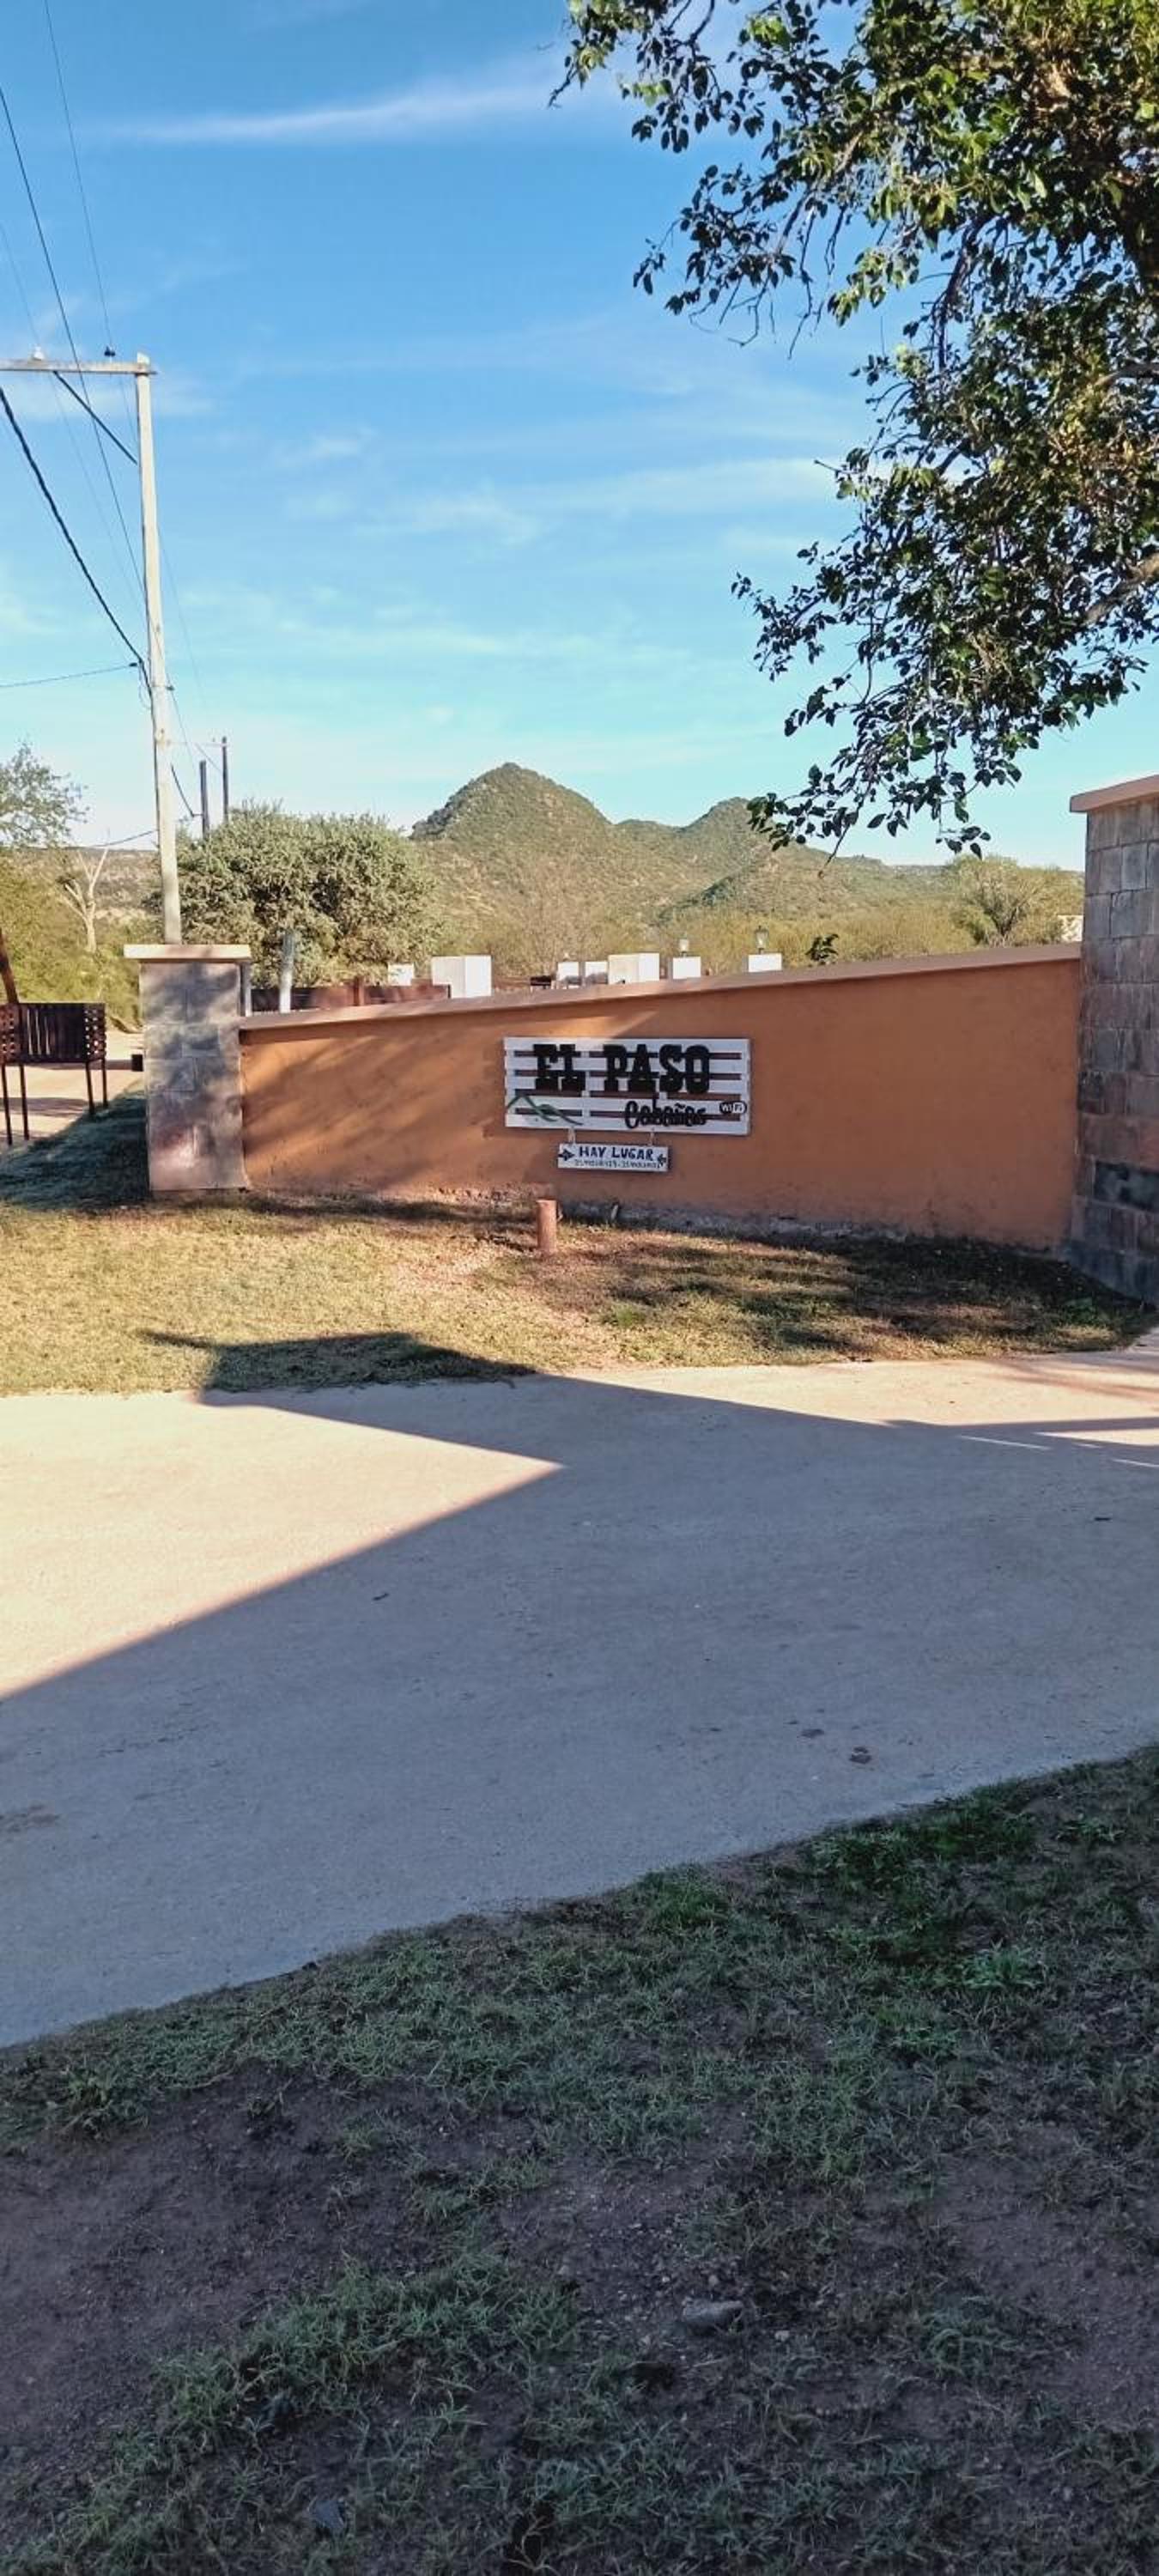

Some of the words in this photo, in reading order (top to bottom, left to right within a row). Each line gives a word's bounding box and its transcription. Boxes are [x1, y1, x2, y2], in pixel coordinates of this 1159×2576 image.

[533, 1044, 586, 1091] EL
[603, 1043, 710, 1093] PASO
[624, 1098, 707, 1128] Cabañas
[579, 1146, 606, 1157] HAY
[612, 1147, 654, 1161] LUGAR
